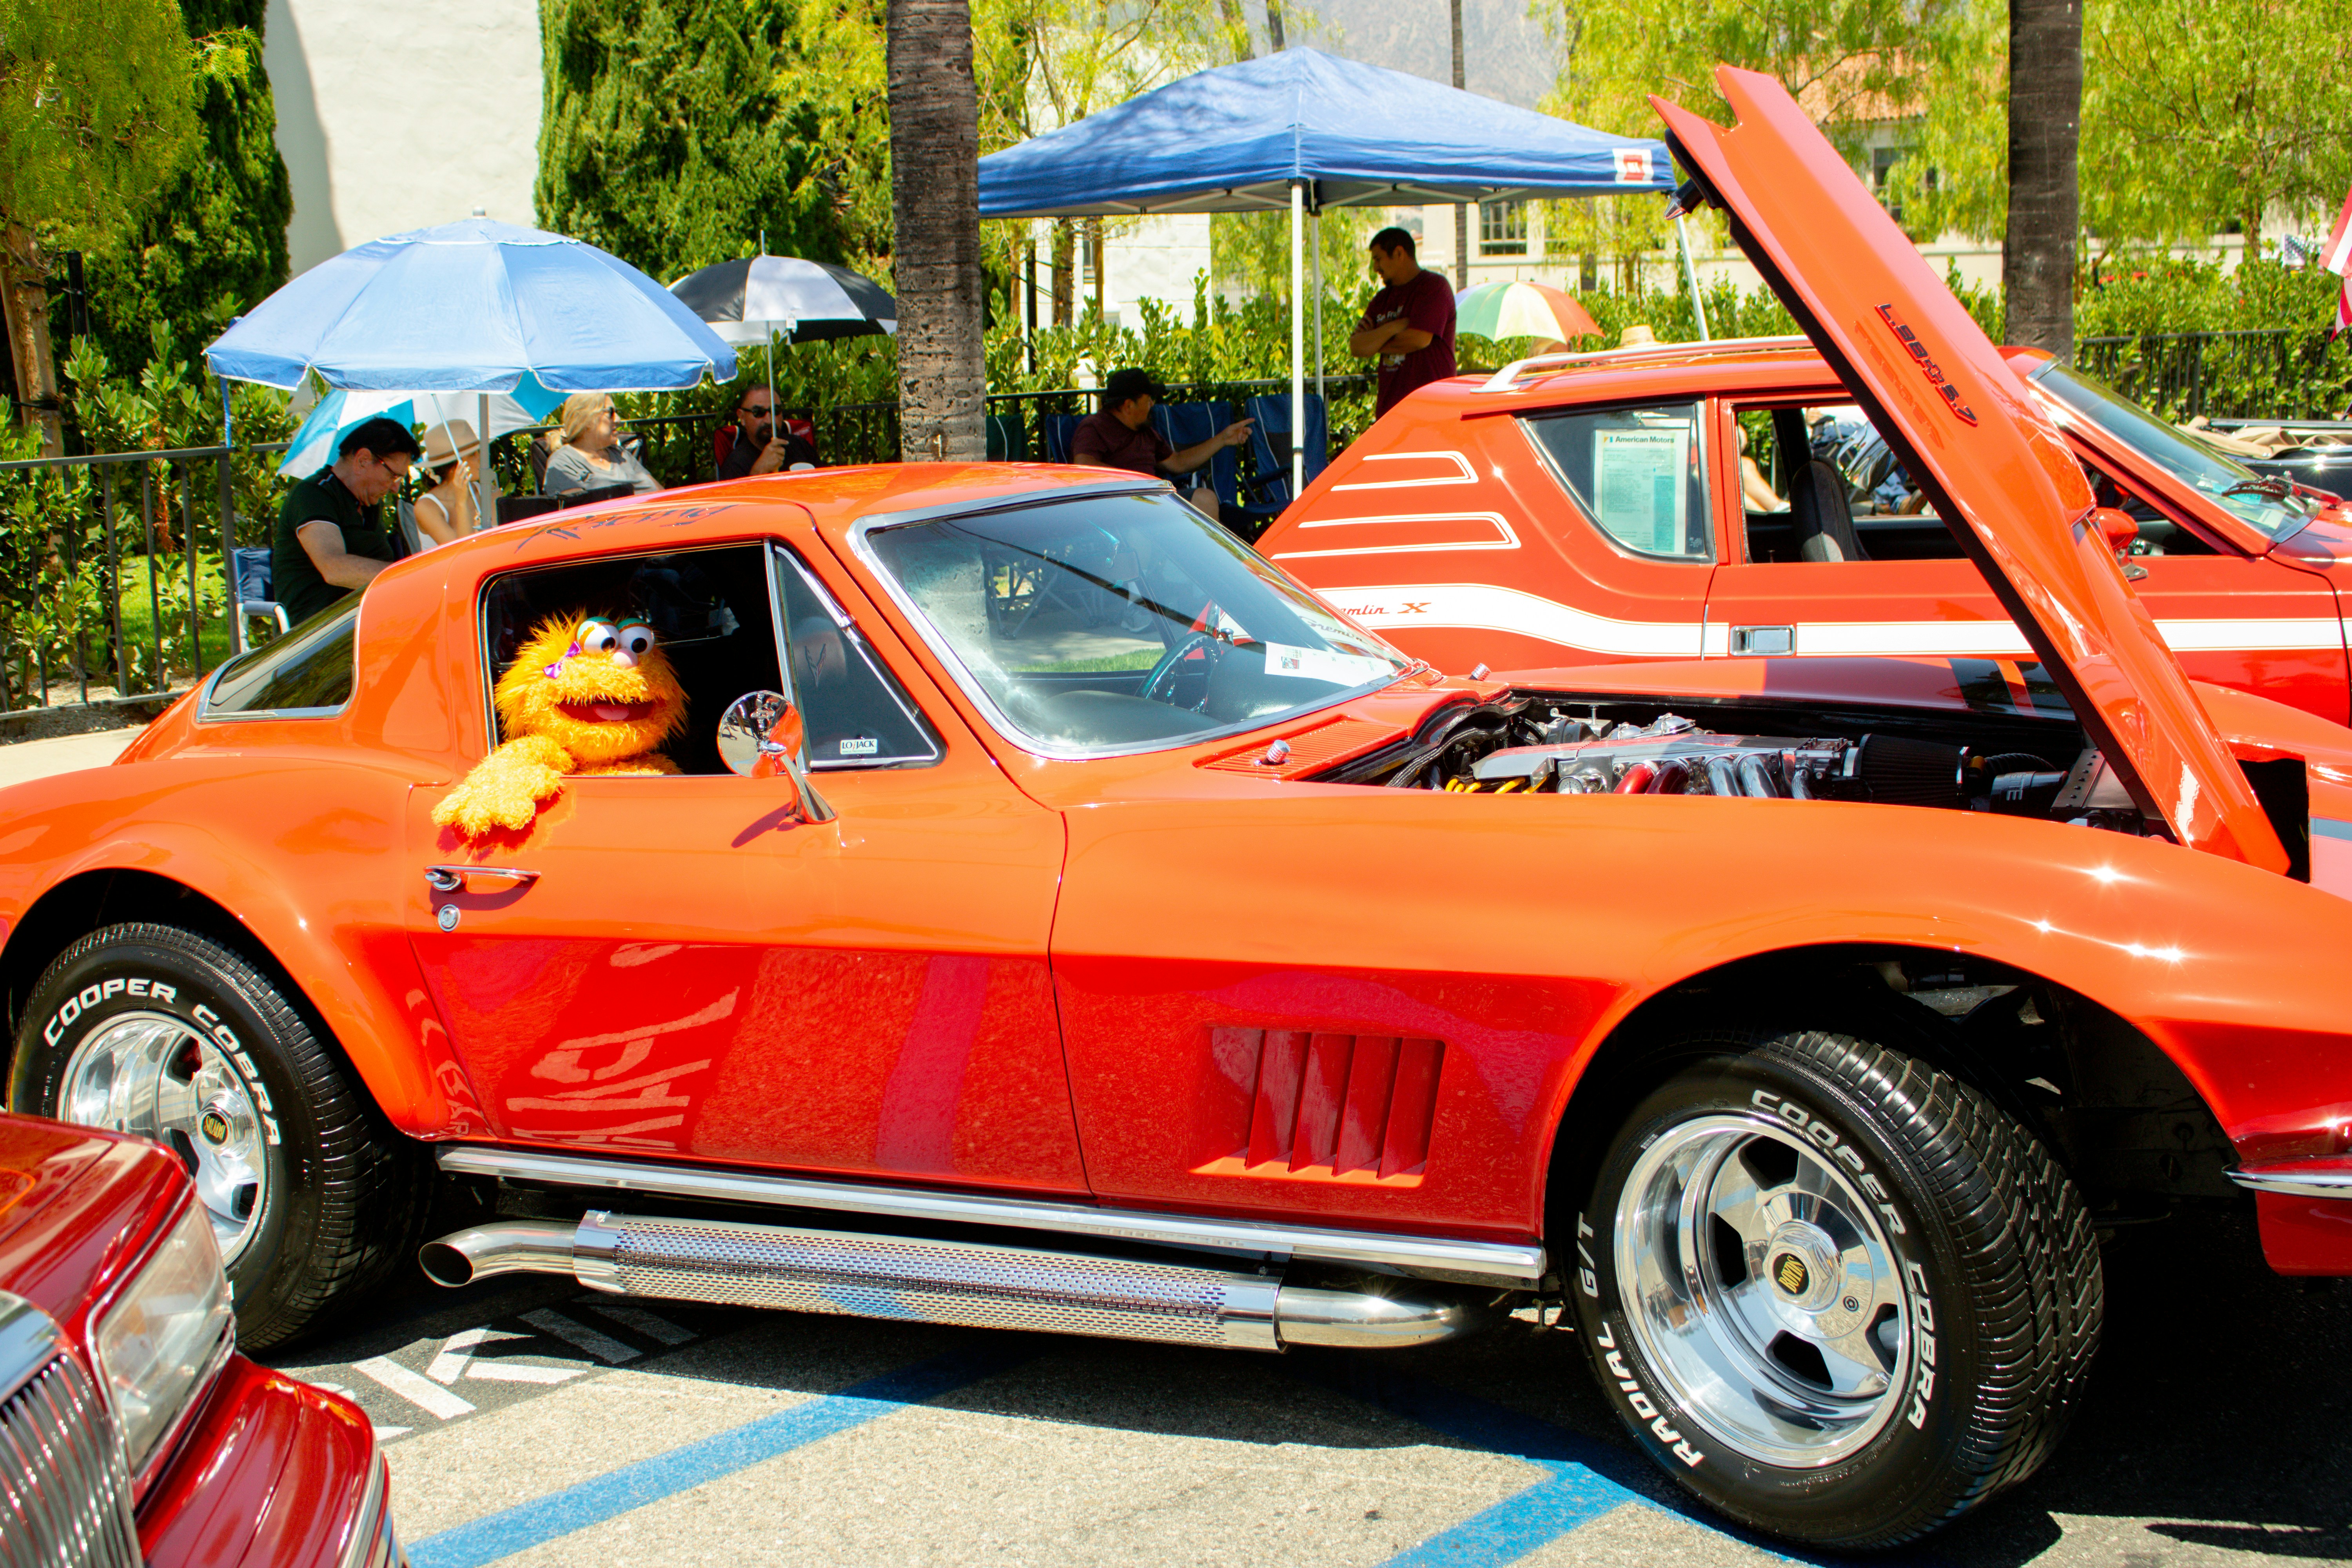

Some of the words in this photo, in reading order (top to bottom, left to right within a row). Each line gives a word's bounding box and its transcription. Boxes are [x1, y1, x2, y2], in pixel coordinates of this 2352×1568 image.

[1938, 384, 1977, 422] 5.7
[1397, 602, 1432, 614] X
[44, 978, 176, 1047] COOPER
[192, 1004, 281, 1146] COBRA
[205, 1116, 227, 1140] BOYDS
[1577, 1211, 1599, 1298] G/T
[1751, 1089, 1906, 1236] COOPER
[1906, 1259, 1936, 1430] COBRA
[1778, 1254, 1807, 1294] BOYDS
[1597, 1321, 1706, 1467] RADIAL
